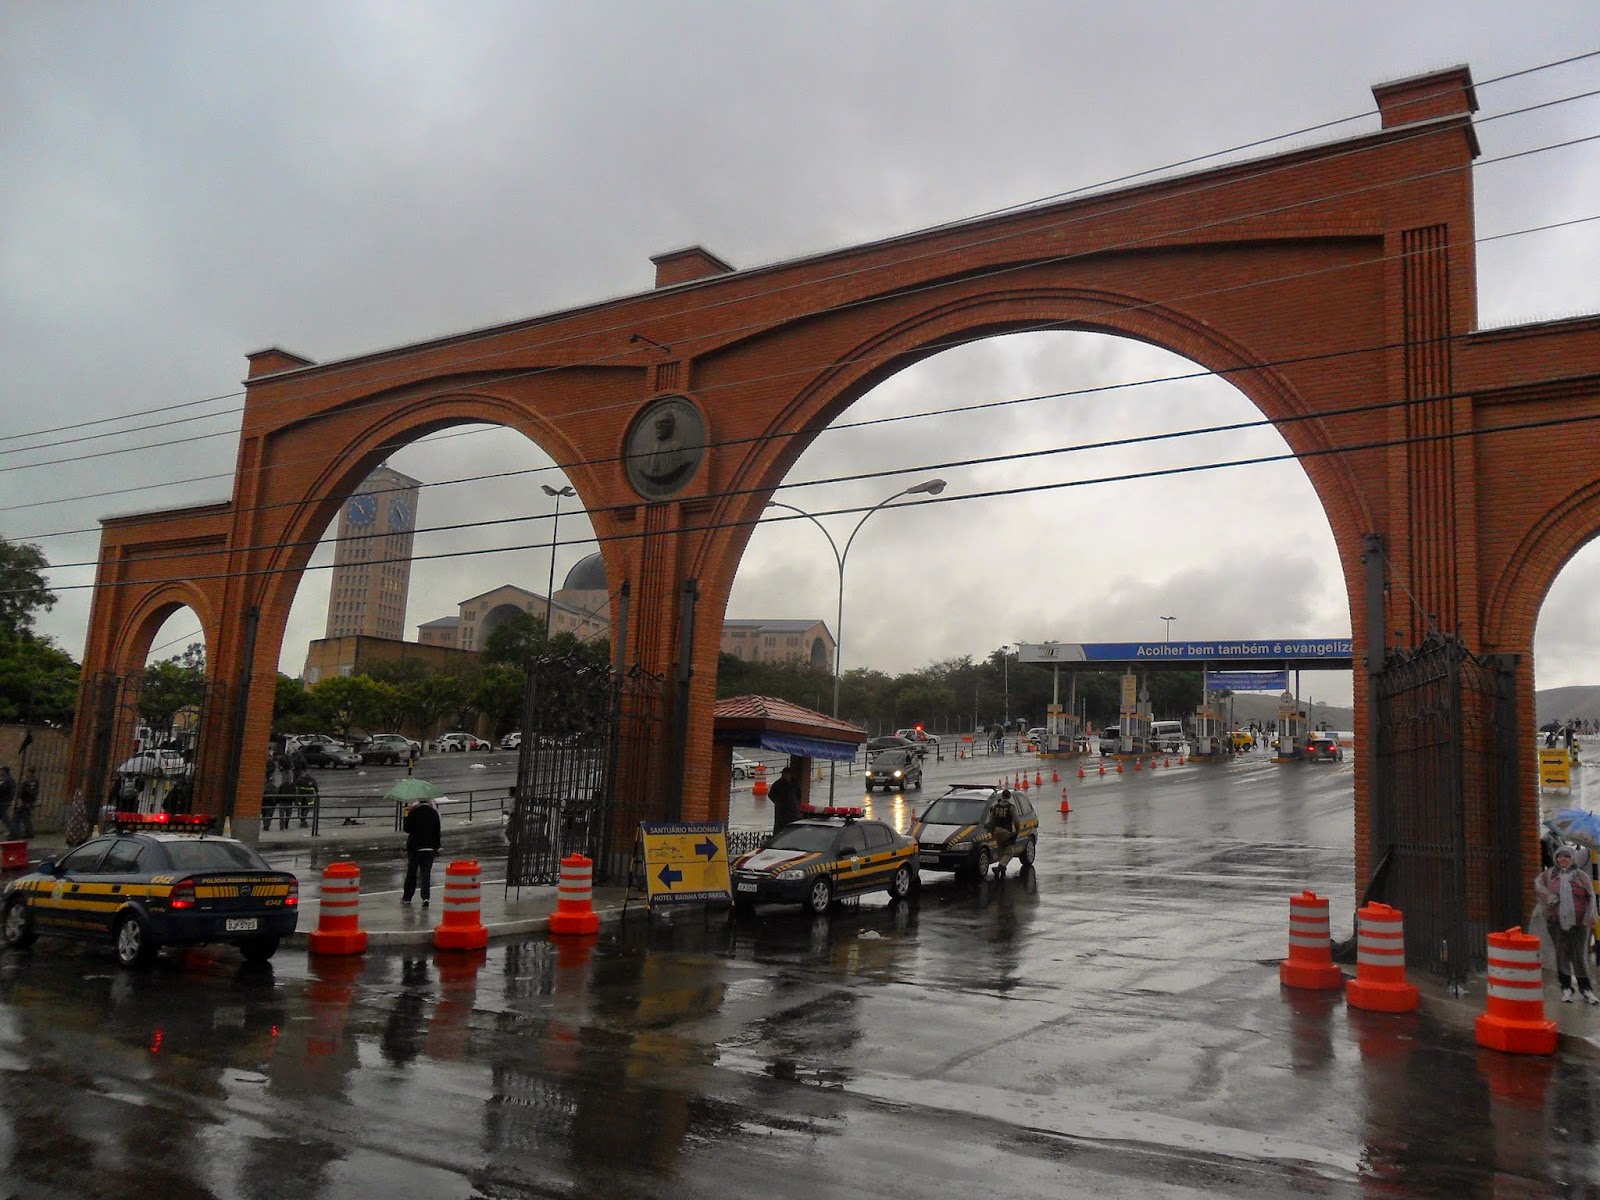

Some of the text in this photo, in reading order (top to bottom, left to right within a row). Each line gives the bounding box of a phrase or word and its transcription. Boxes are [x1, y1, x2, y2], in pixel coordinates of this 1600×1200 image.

[1136, 645, 1184, 656] Acolher
[1187, 644, 1214, 655] bem
[1218, 643, 1270, 655] também
[1273, 643, 1282, 654] é
[995, 808, 1009, 817] PRF
[650, 826, 687, 834] SANTUÁRIO
